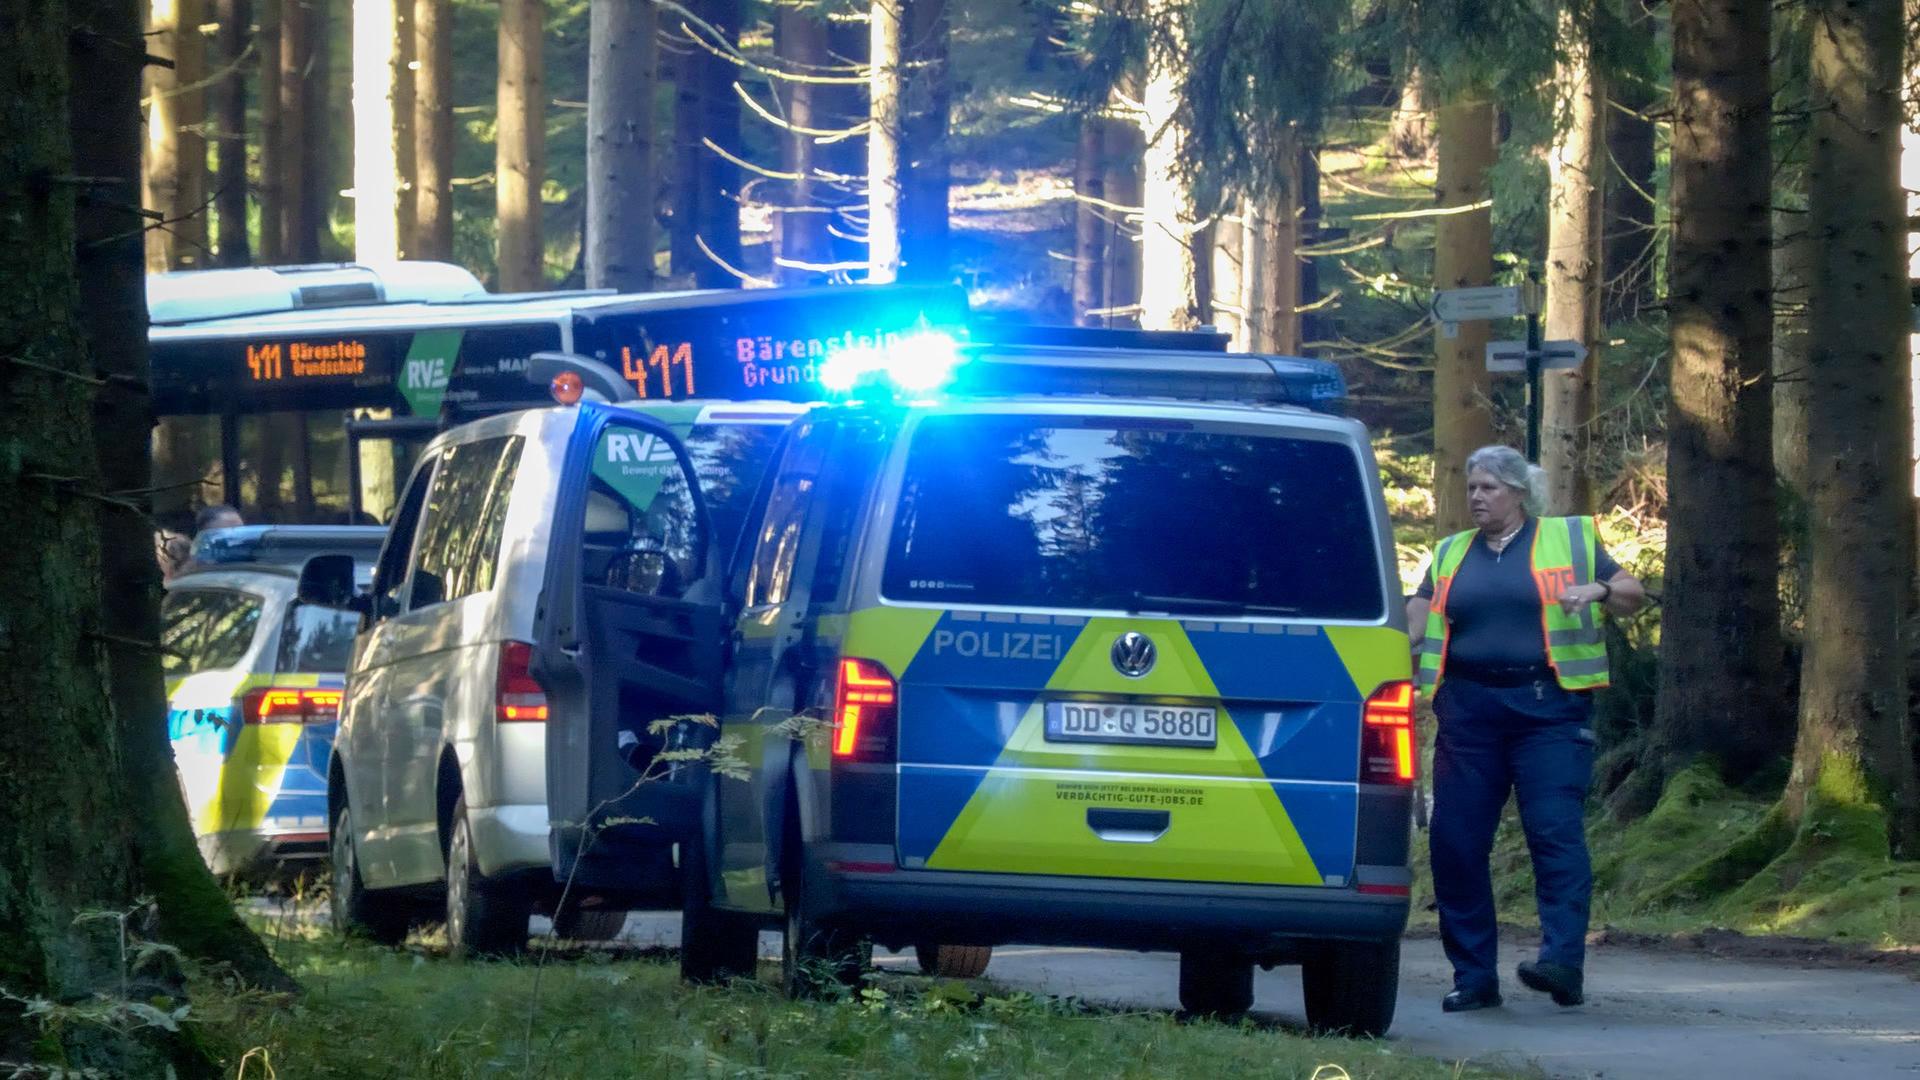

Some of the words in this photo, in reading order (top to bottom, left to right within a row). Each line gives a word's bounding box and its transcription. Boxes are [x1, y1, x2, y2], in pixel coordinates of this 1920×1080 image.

[246, 344, 282, 379] 411
[622, 342, 695, 398] 411
[934, 630, 1061, 660] POLIZEI
[1065, 706, 1100, 732] DD
[1120, 708, 1137, 733] Q
[1144, 709, 1212, 737] 5880
